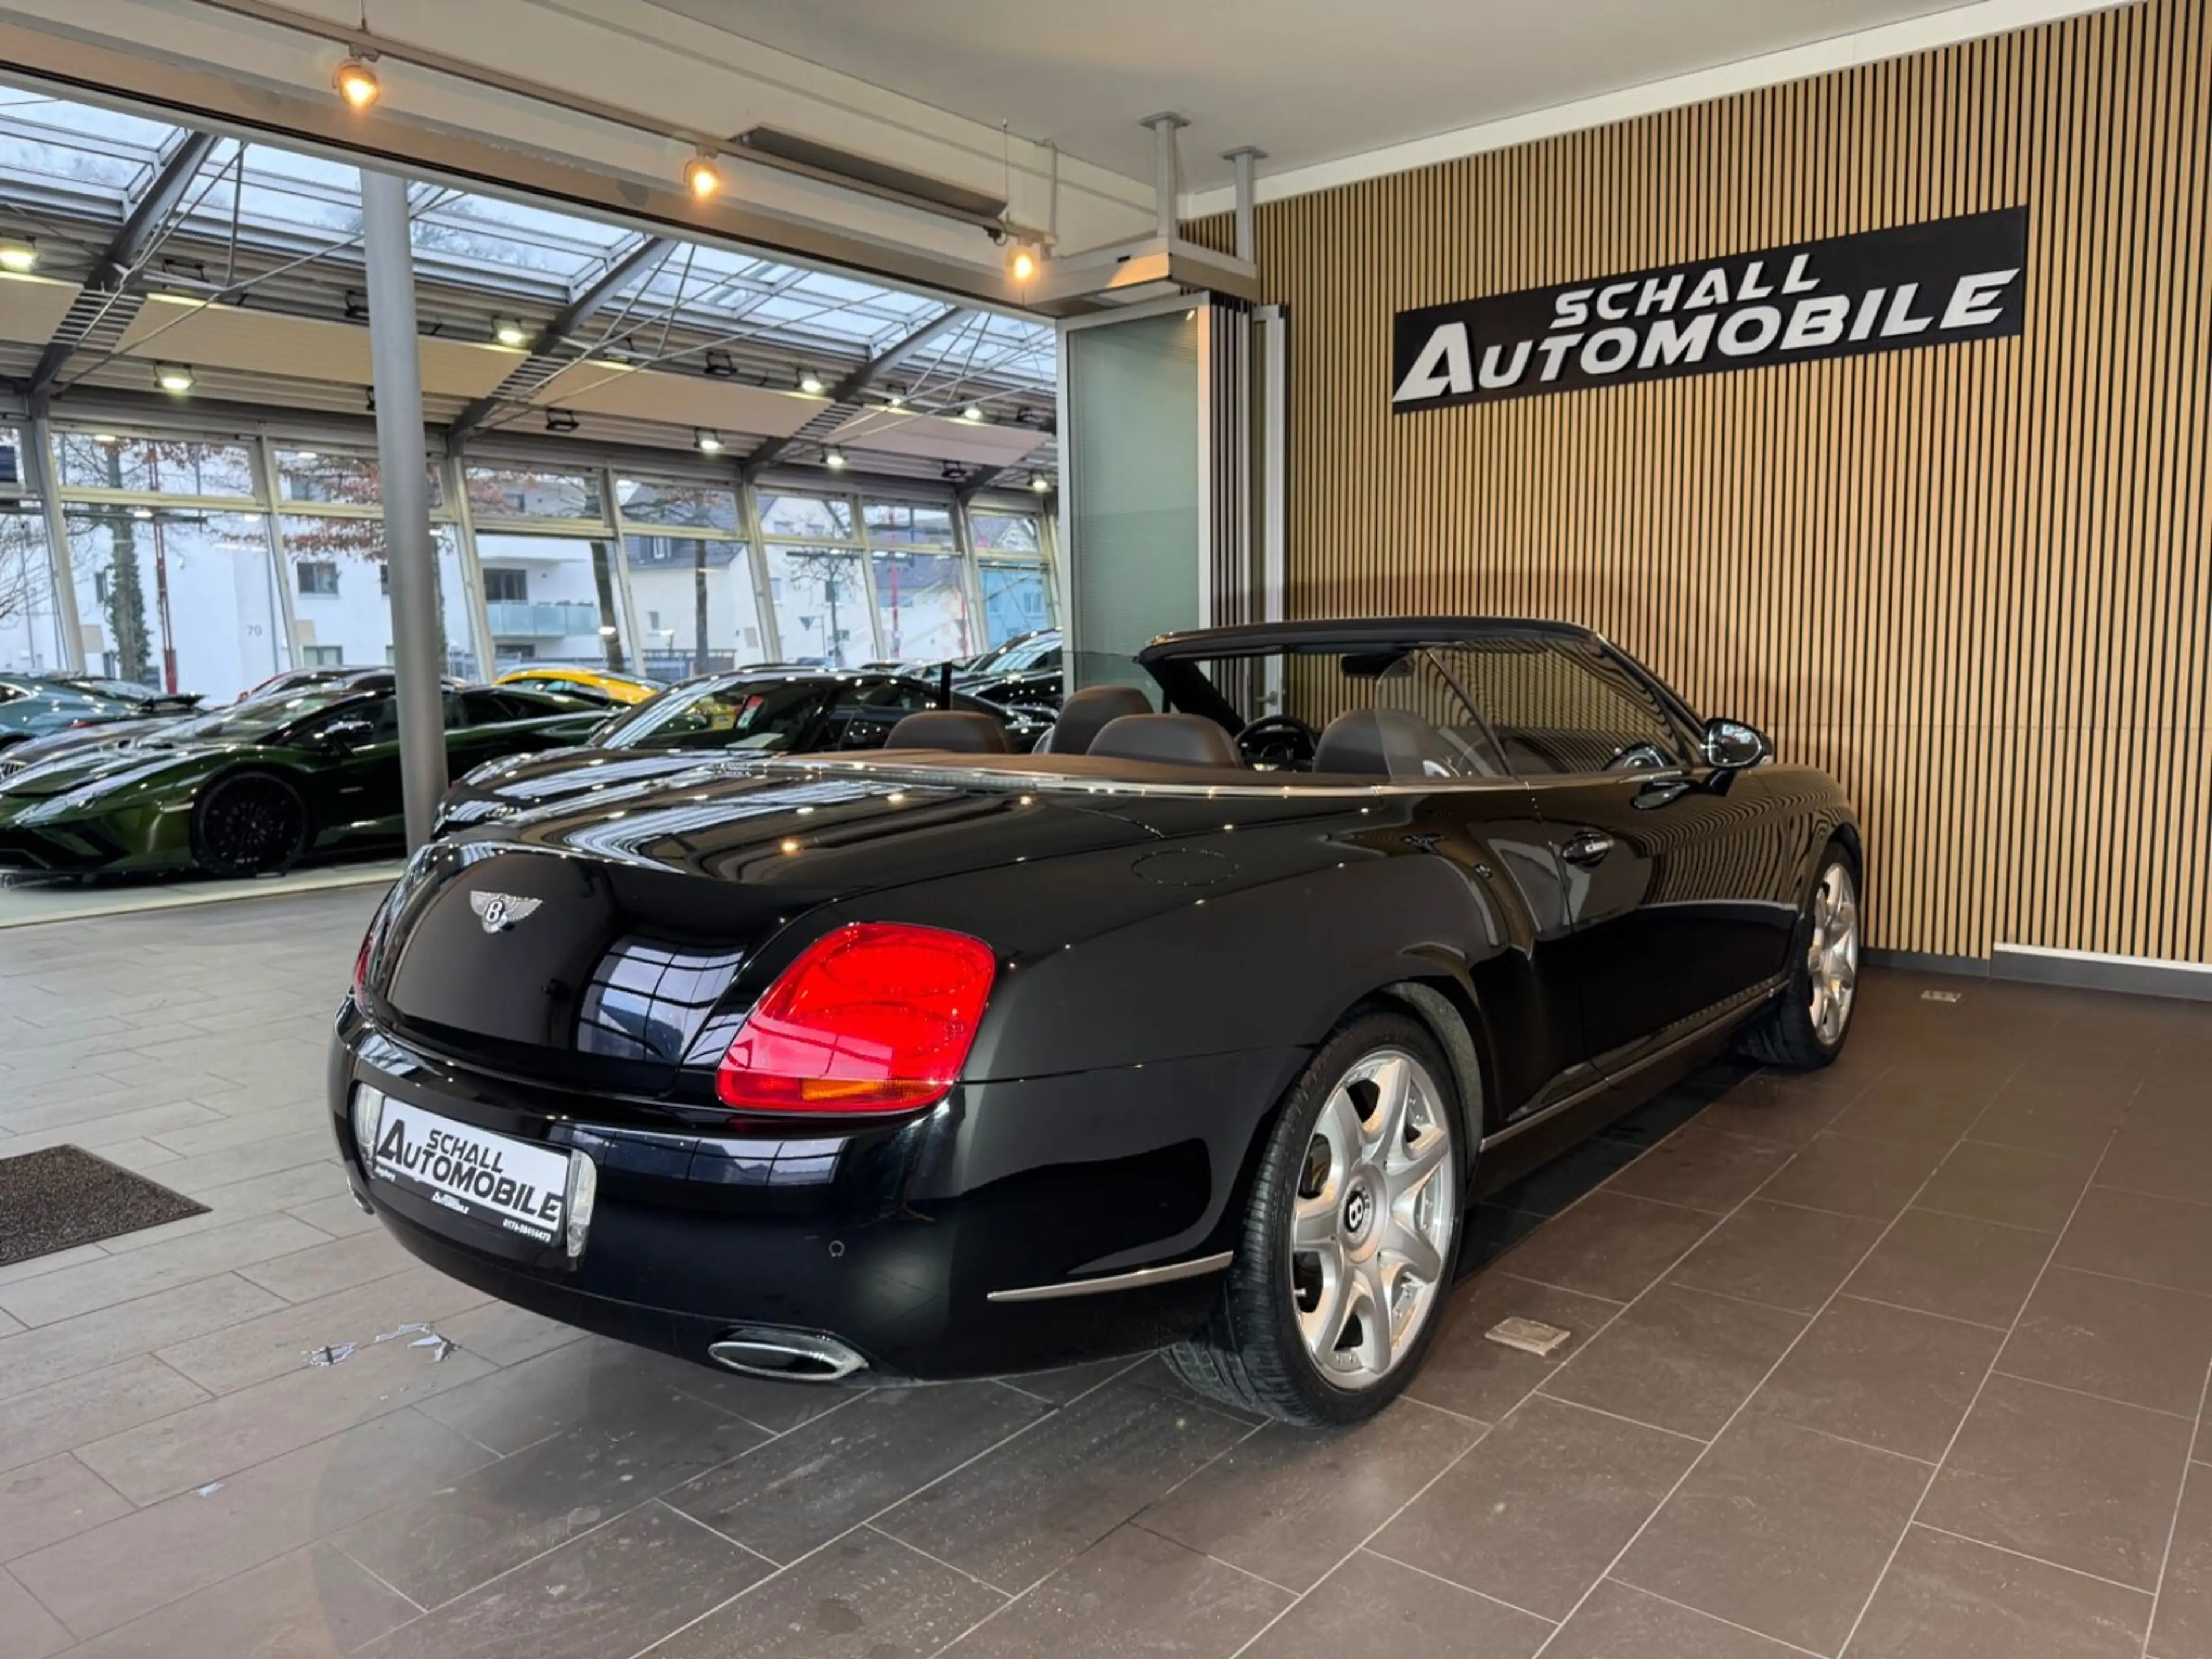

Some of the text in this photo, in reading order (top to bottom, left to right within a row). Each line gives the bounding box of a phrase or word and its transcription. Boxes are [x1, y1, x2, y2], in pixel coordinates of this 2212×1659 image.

[1392, 268, 2020, 403] AUTOMOBILE
[1549, 253, 1820, 329] SCHALL
[376, 1119, 563, 1222] AUTOMOBILE
[426, 1129, 503, 1173] SCHALL
